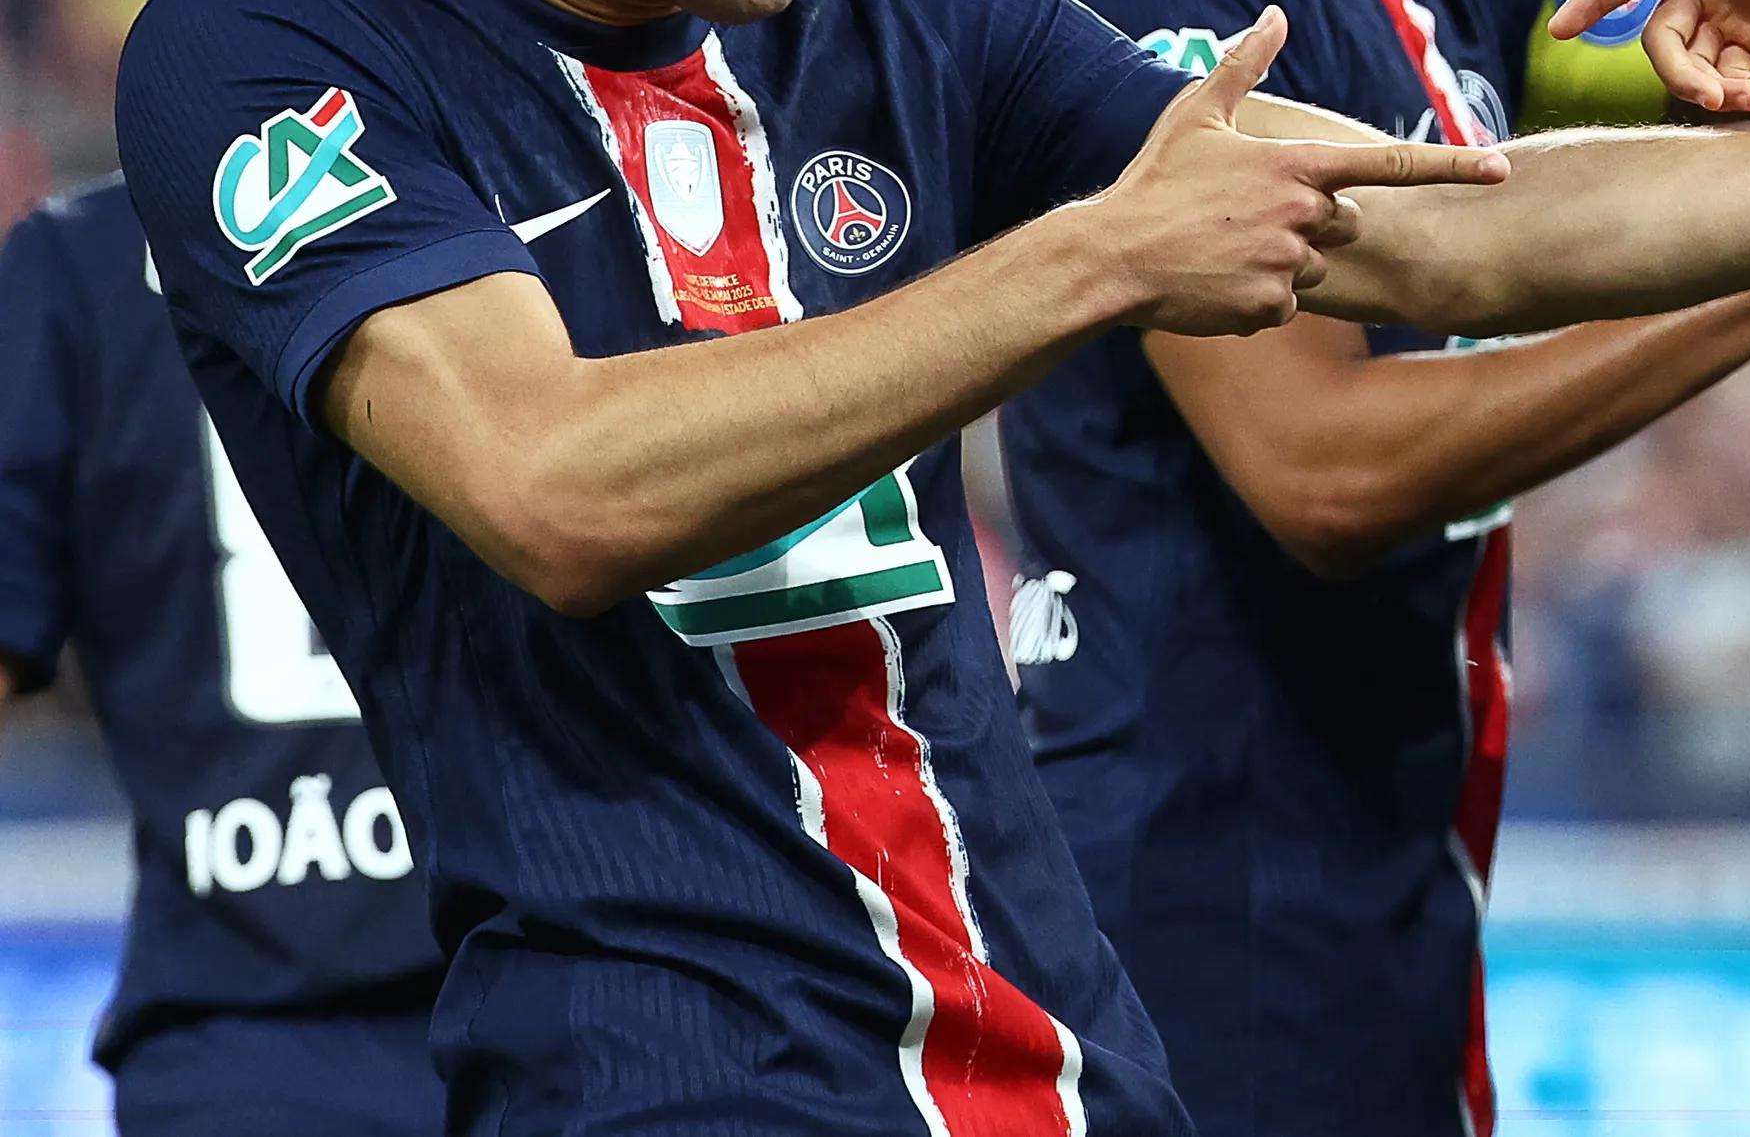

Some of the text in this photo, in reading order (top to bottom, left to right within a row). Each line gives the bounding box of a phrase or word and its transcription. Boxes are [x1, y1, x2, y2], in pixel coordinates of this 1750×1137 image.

[801, 157, 873, 193] PARIS
[731, 285, 754, 301] 2025
[724, 300, 753, 315] STADE
[752, 296, 766, 310] DE
